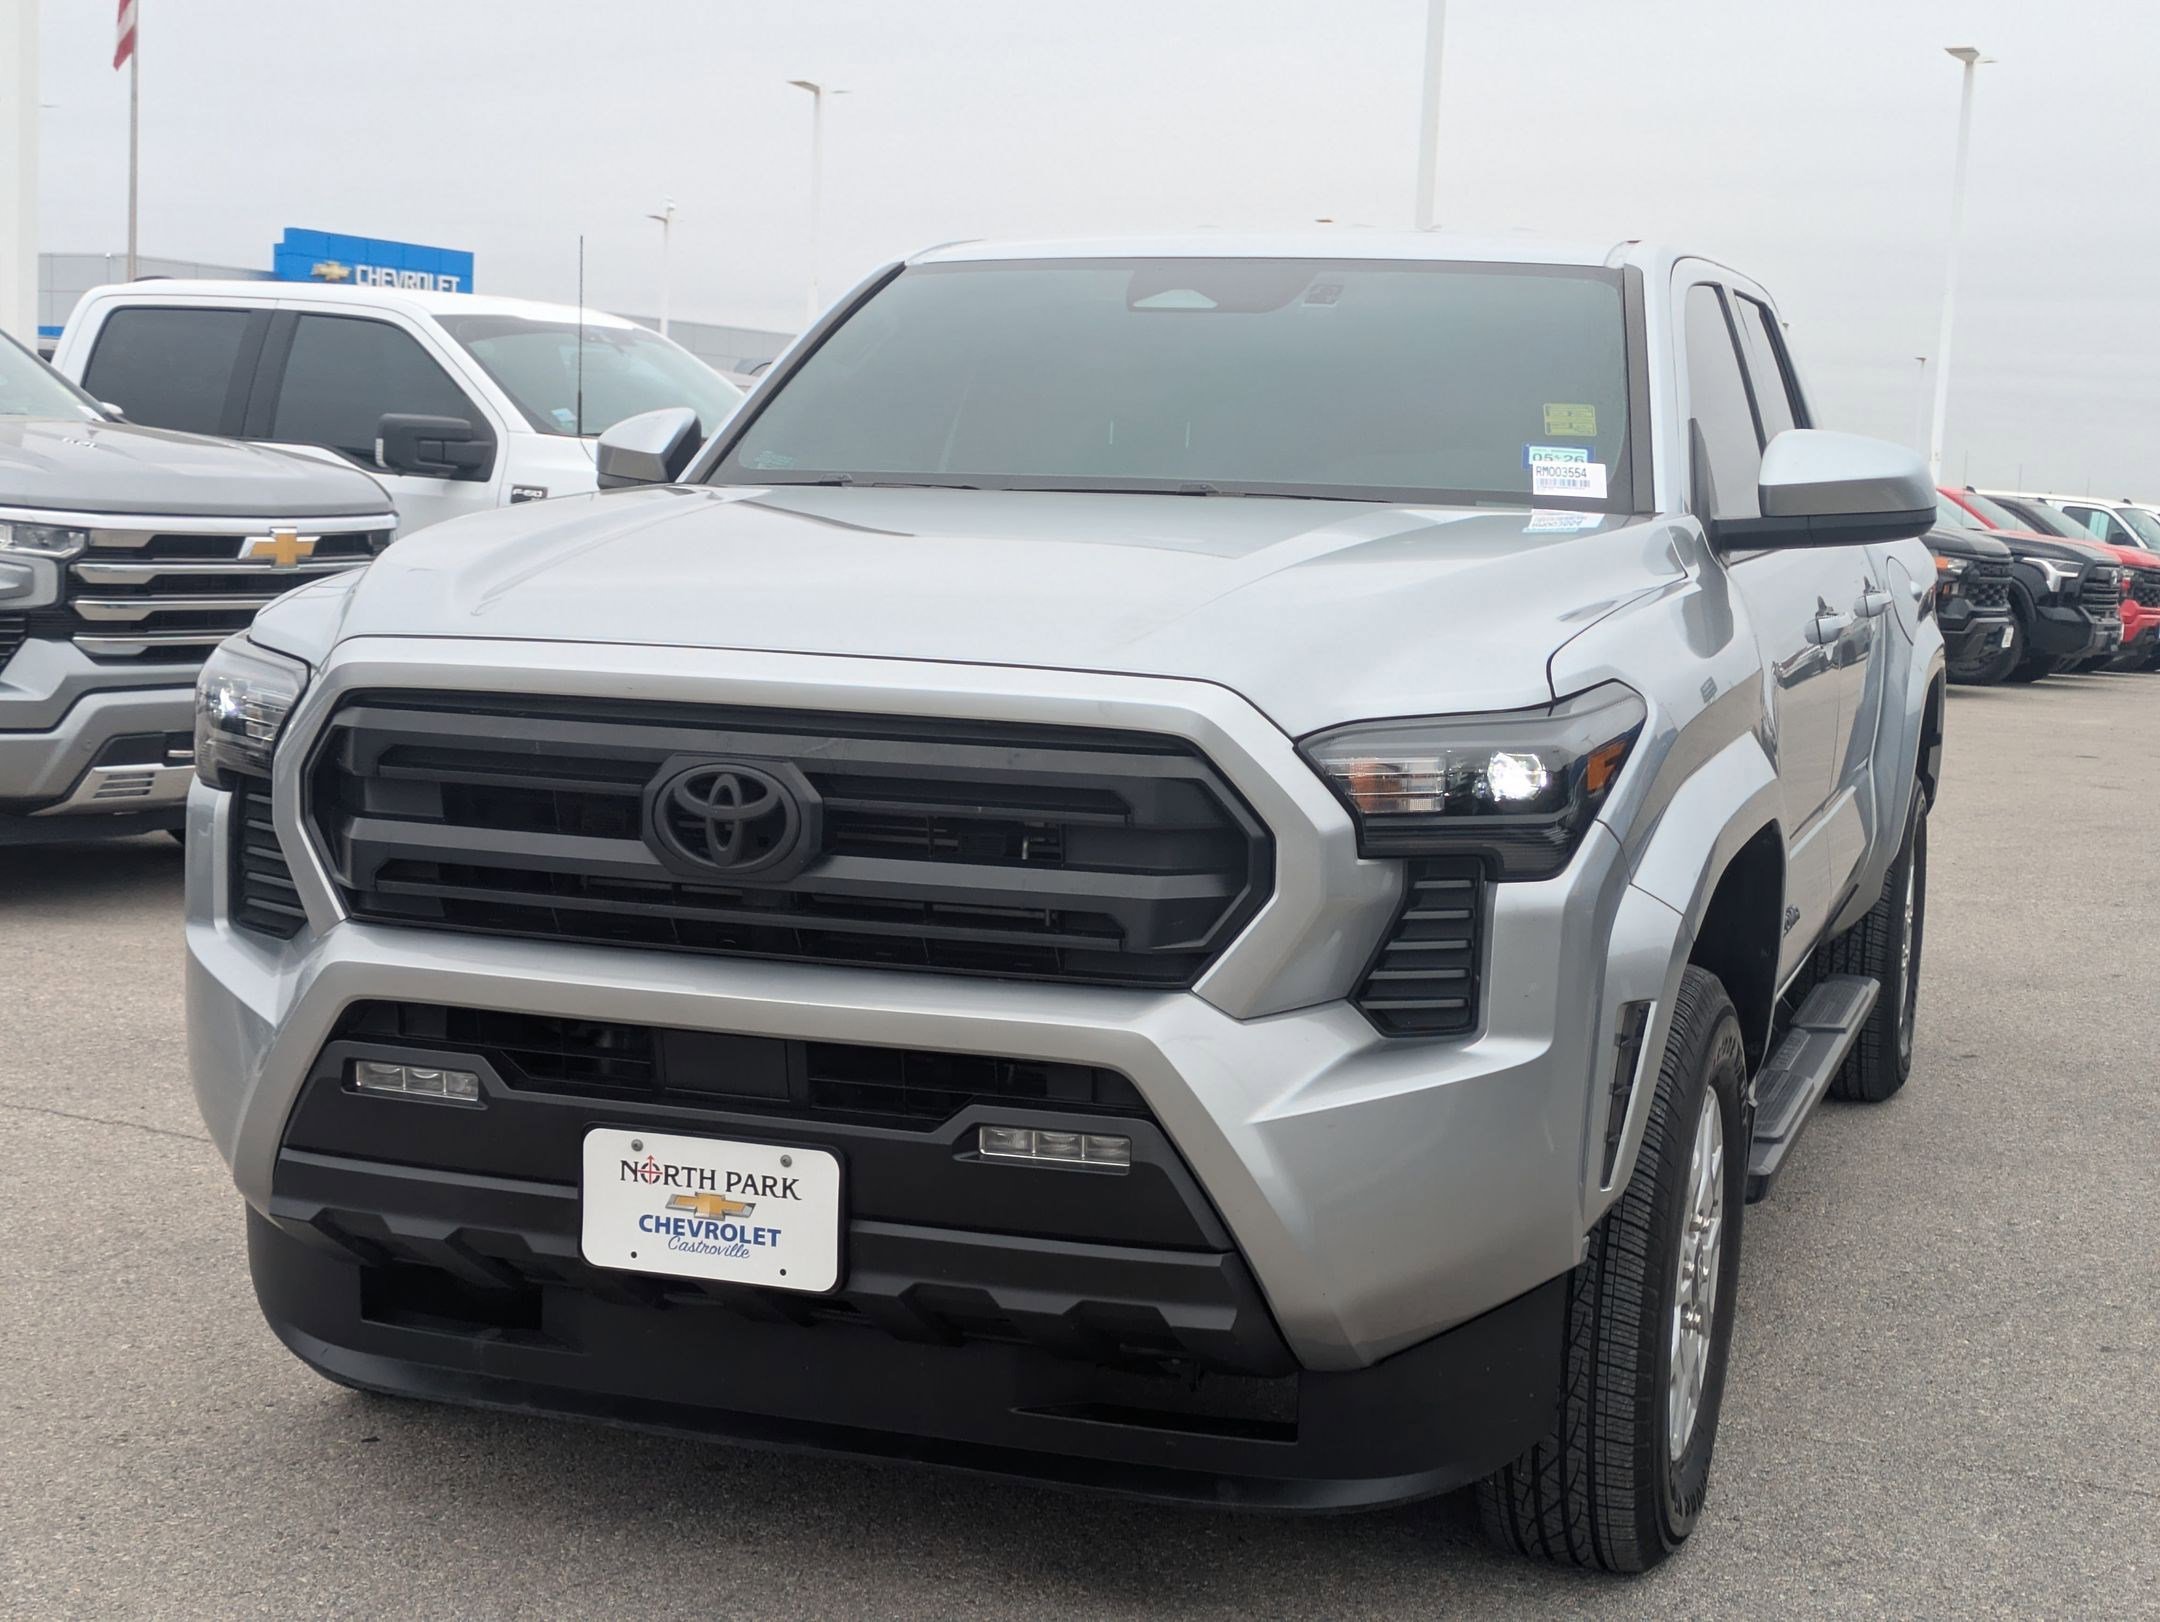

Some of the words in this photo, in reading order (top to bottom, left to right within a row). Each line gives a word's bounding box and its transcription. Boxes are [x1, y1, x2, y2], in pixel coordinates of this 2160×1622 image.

[355, 264, 461, 293] CHEVROLET
[1535, 465, 1588, 479] RM003554
[619, 1156, 717, 1191] NORTH
[725, 1171, 803, 1201] PARK
[638, 1214, 782, 1248] CHEVROLET
[667, 1235, 751, 1260] Castroville
